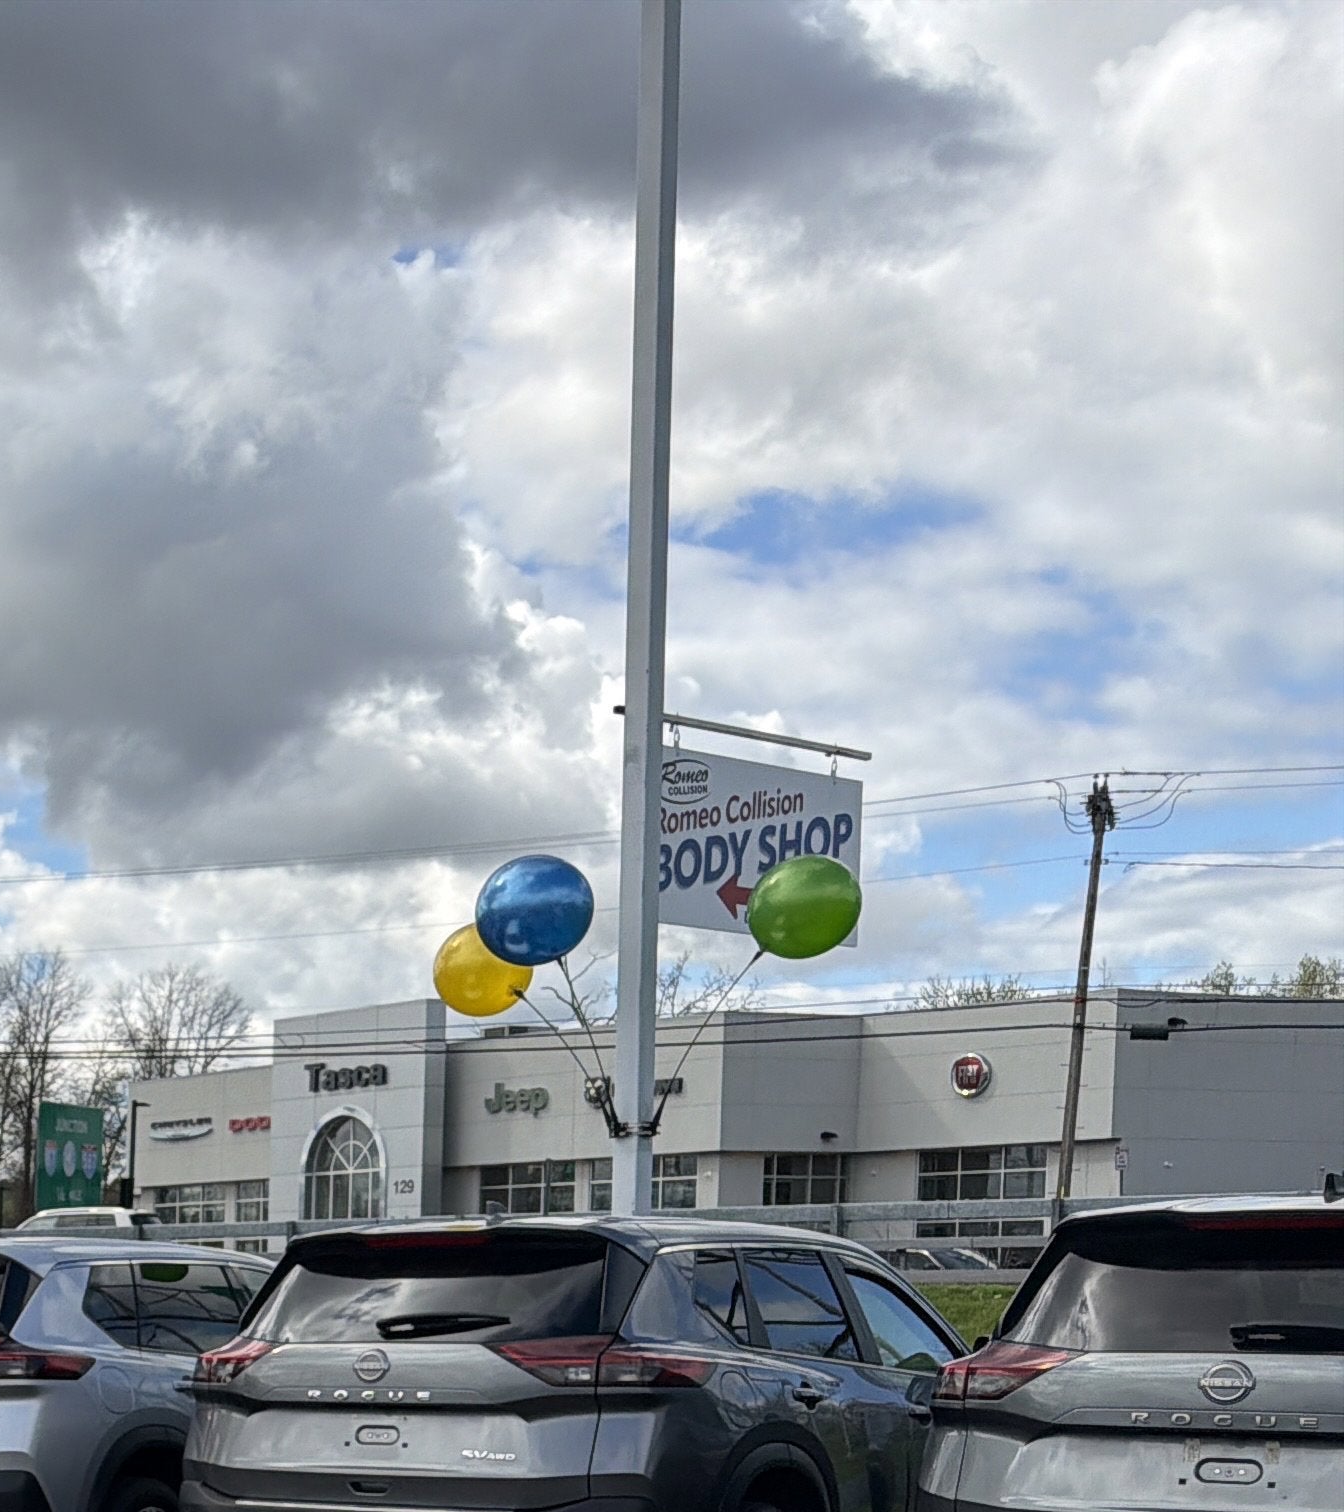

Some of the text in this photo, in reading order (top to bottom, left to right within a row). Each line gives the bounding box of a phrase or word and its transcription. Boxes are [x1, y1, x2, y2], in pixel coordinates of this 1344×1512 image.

[662, 761, 709, 784] Romeo
[668, 785, 709, 796] COLLISION
[725, 788, 804, 823] Collision
[756, 813, 853, 875] SHOP
[304, 1063, 389, 1093] Tasca
[484, 1083, 550, 1118] Jeep
[393, 1180, 415, 1194] 129
[1199, 1378, 1254, 1389] NISSAN
[307, 1389, 431, 1401] ROGUE
[1131, 1412, 1319, 1429] ROGUE
